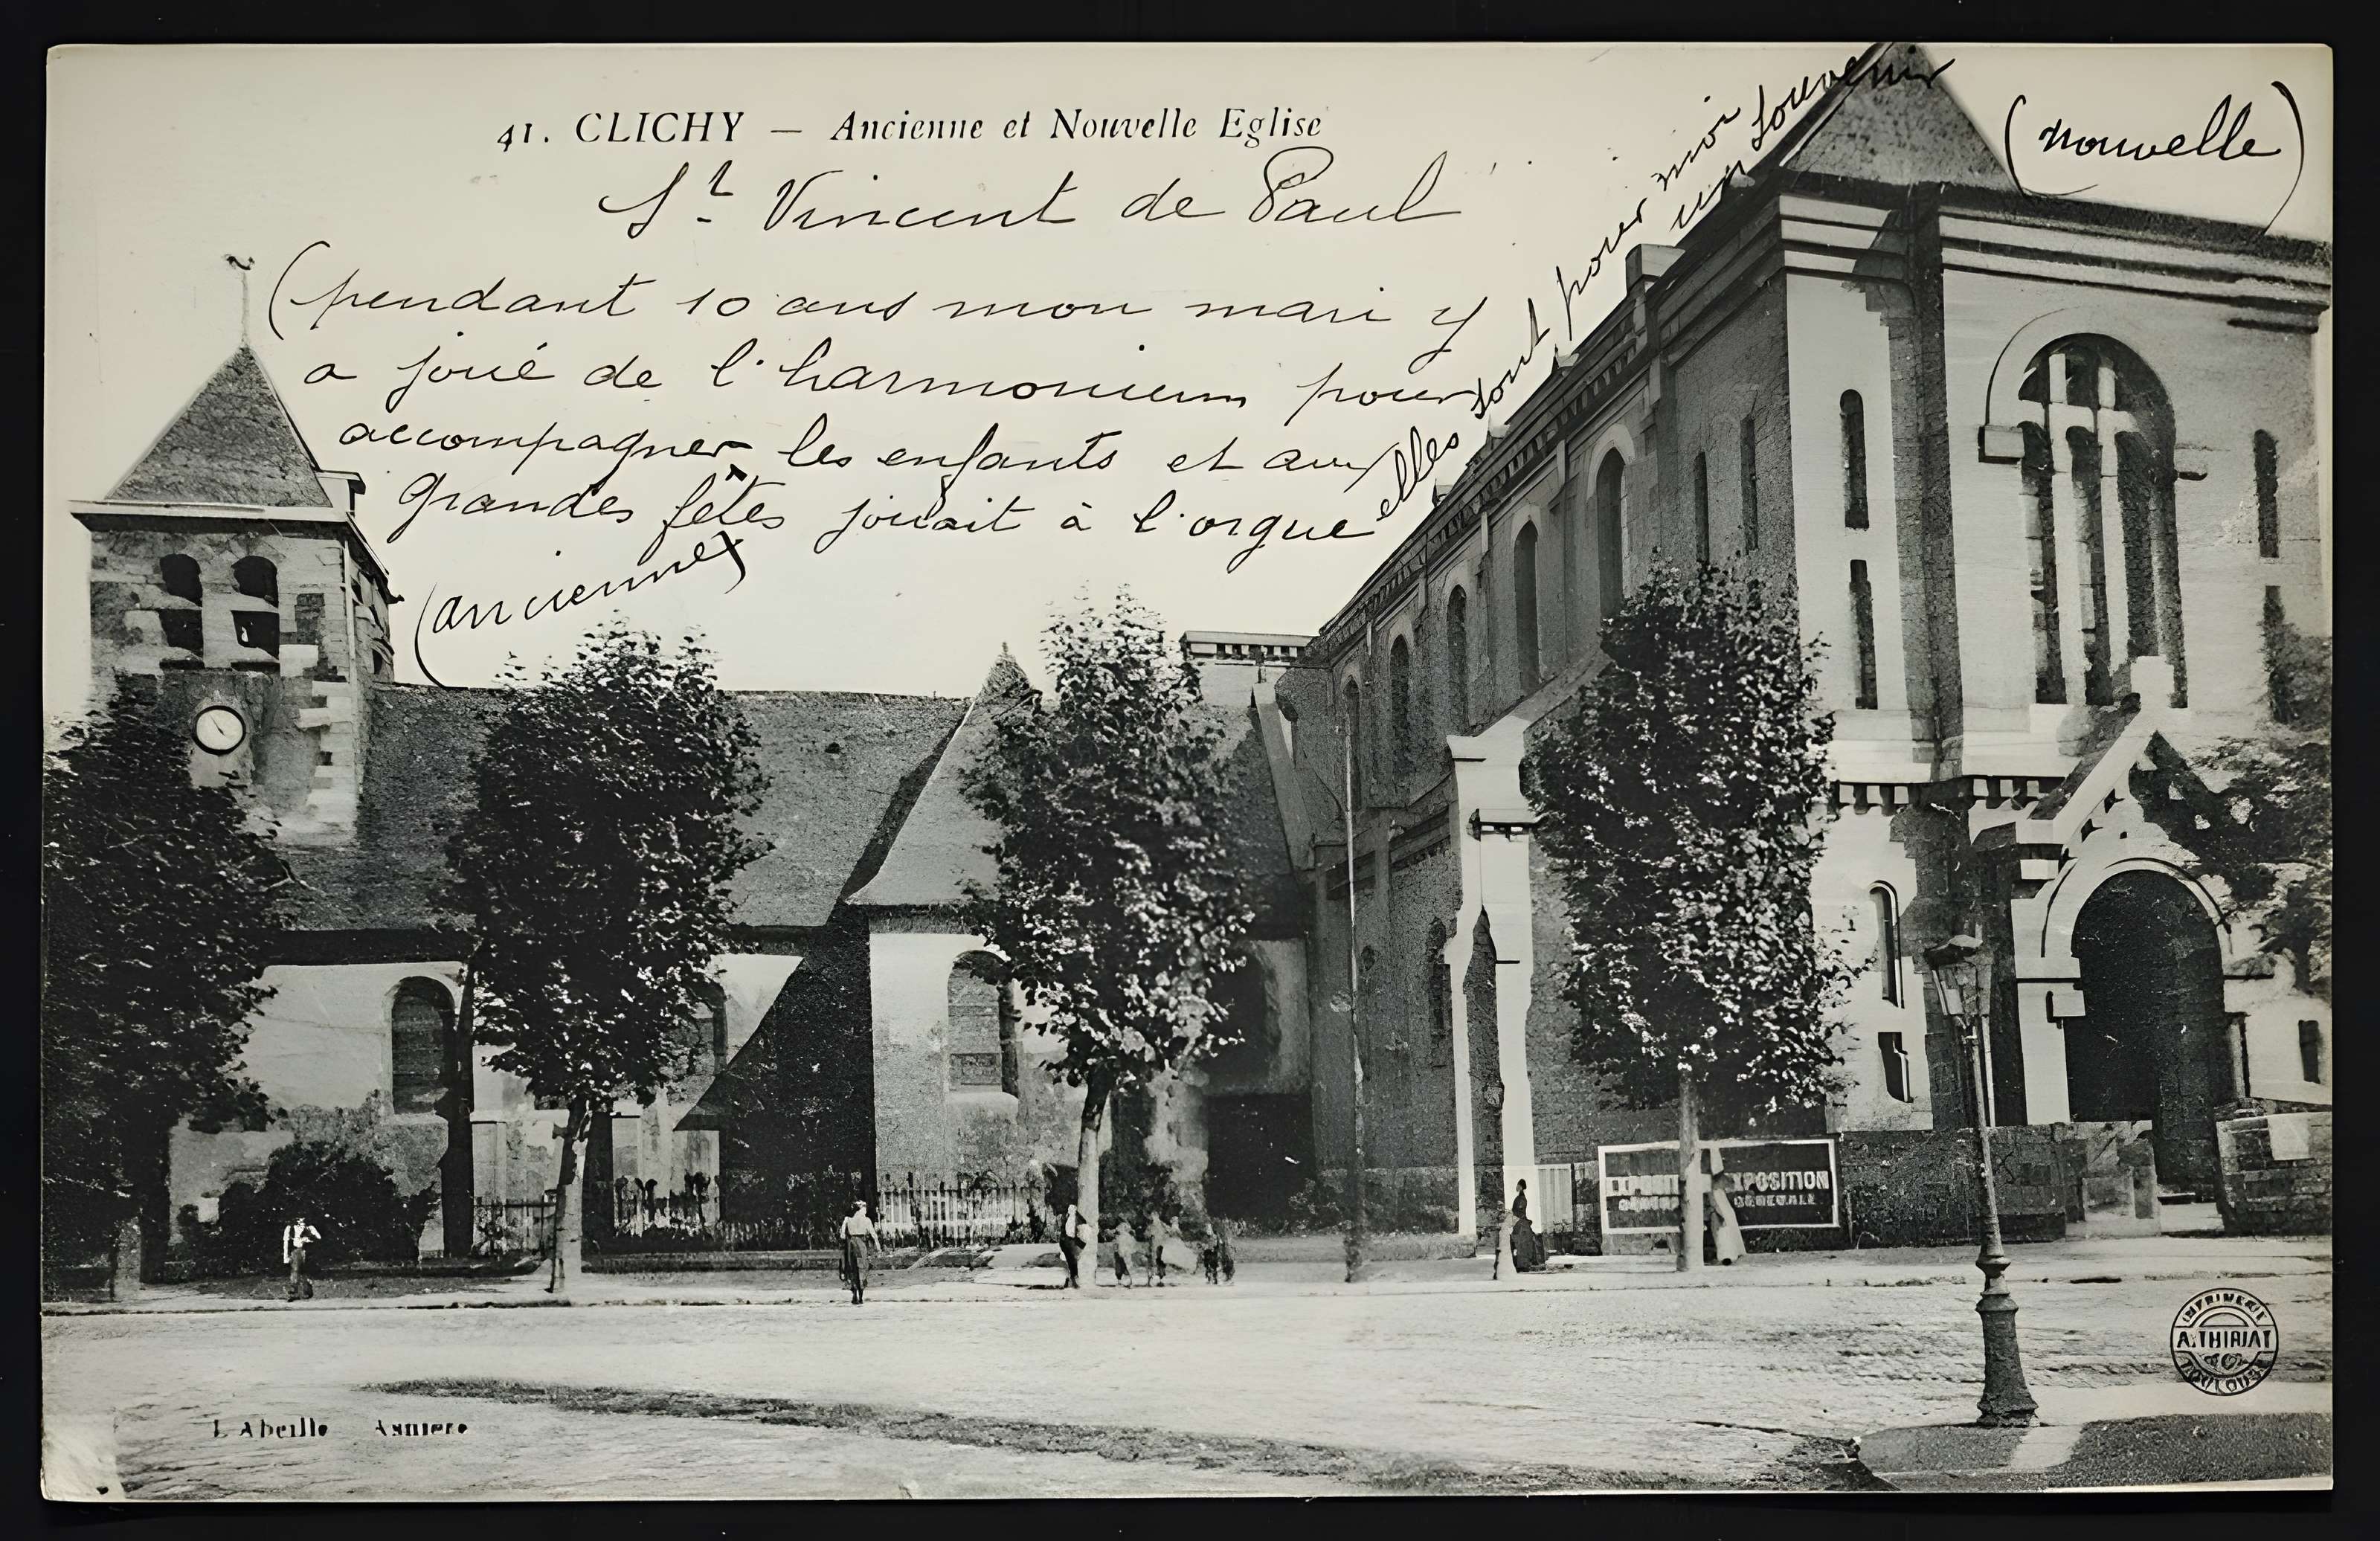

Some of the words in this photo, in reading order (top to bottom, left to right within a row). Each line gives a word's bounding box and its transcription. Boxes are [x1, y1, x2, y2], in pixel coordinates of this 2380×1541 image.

[763, 170, 1078, 231] Vincent
[1121, 178, 1225, 220] de
[1248, 146, 1461, 223] Paul
[1670, 159, 1746, 232] un
[676, 286, 750, 317] 10
[776, 292, 918, 322] ans
[933, 297, 1152, 321] mon
[1186, 286, 1392, 323] mari
[1408, 296, 1488, 375] y
[1376, 426, 1458, 521] elles
[1470, 297, 1550, 418] sont
[1556, 198, 1647, 341] pour
[303, 361, 358, 384] a
[384, 331, 556, 411] joué
[583, 355, 663, 389] de
[1284, 364, 1473, 425] pour
[339, 419, 753, 489] accompagner
[779, 413, 854, 469] les
[877, 422, 1123, 507] enfants
[1167, 436, 1244, 472] et
[1263, 442, 1400, 493] aux
[637, 463, 787, 565] fêtes
[814, 494, 1035, 554] jouait
[1061, 503, 1092, 532] à
